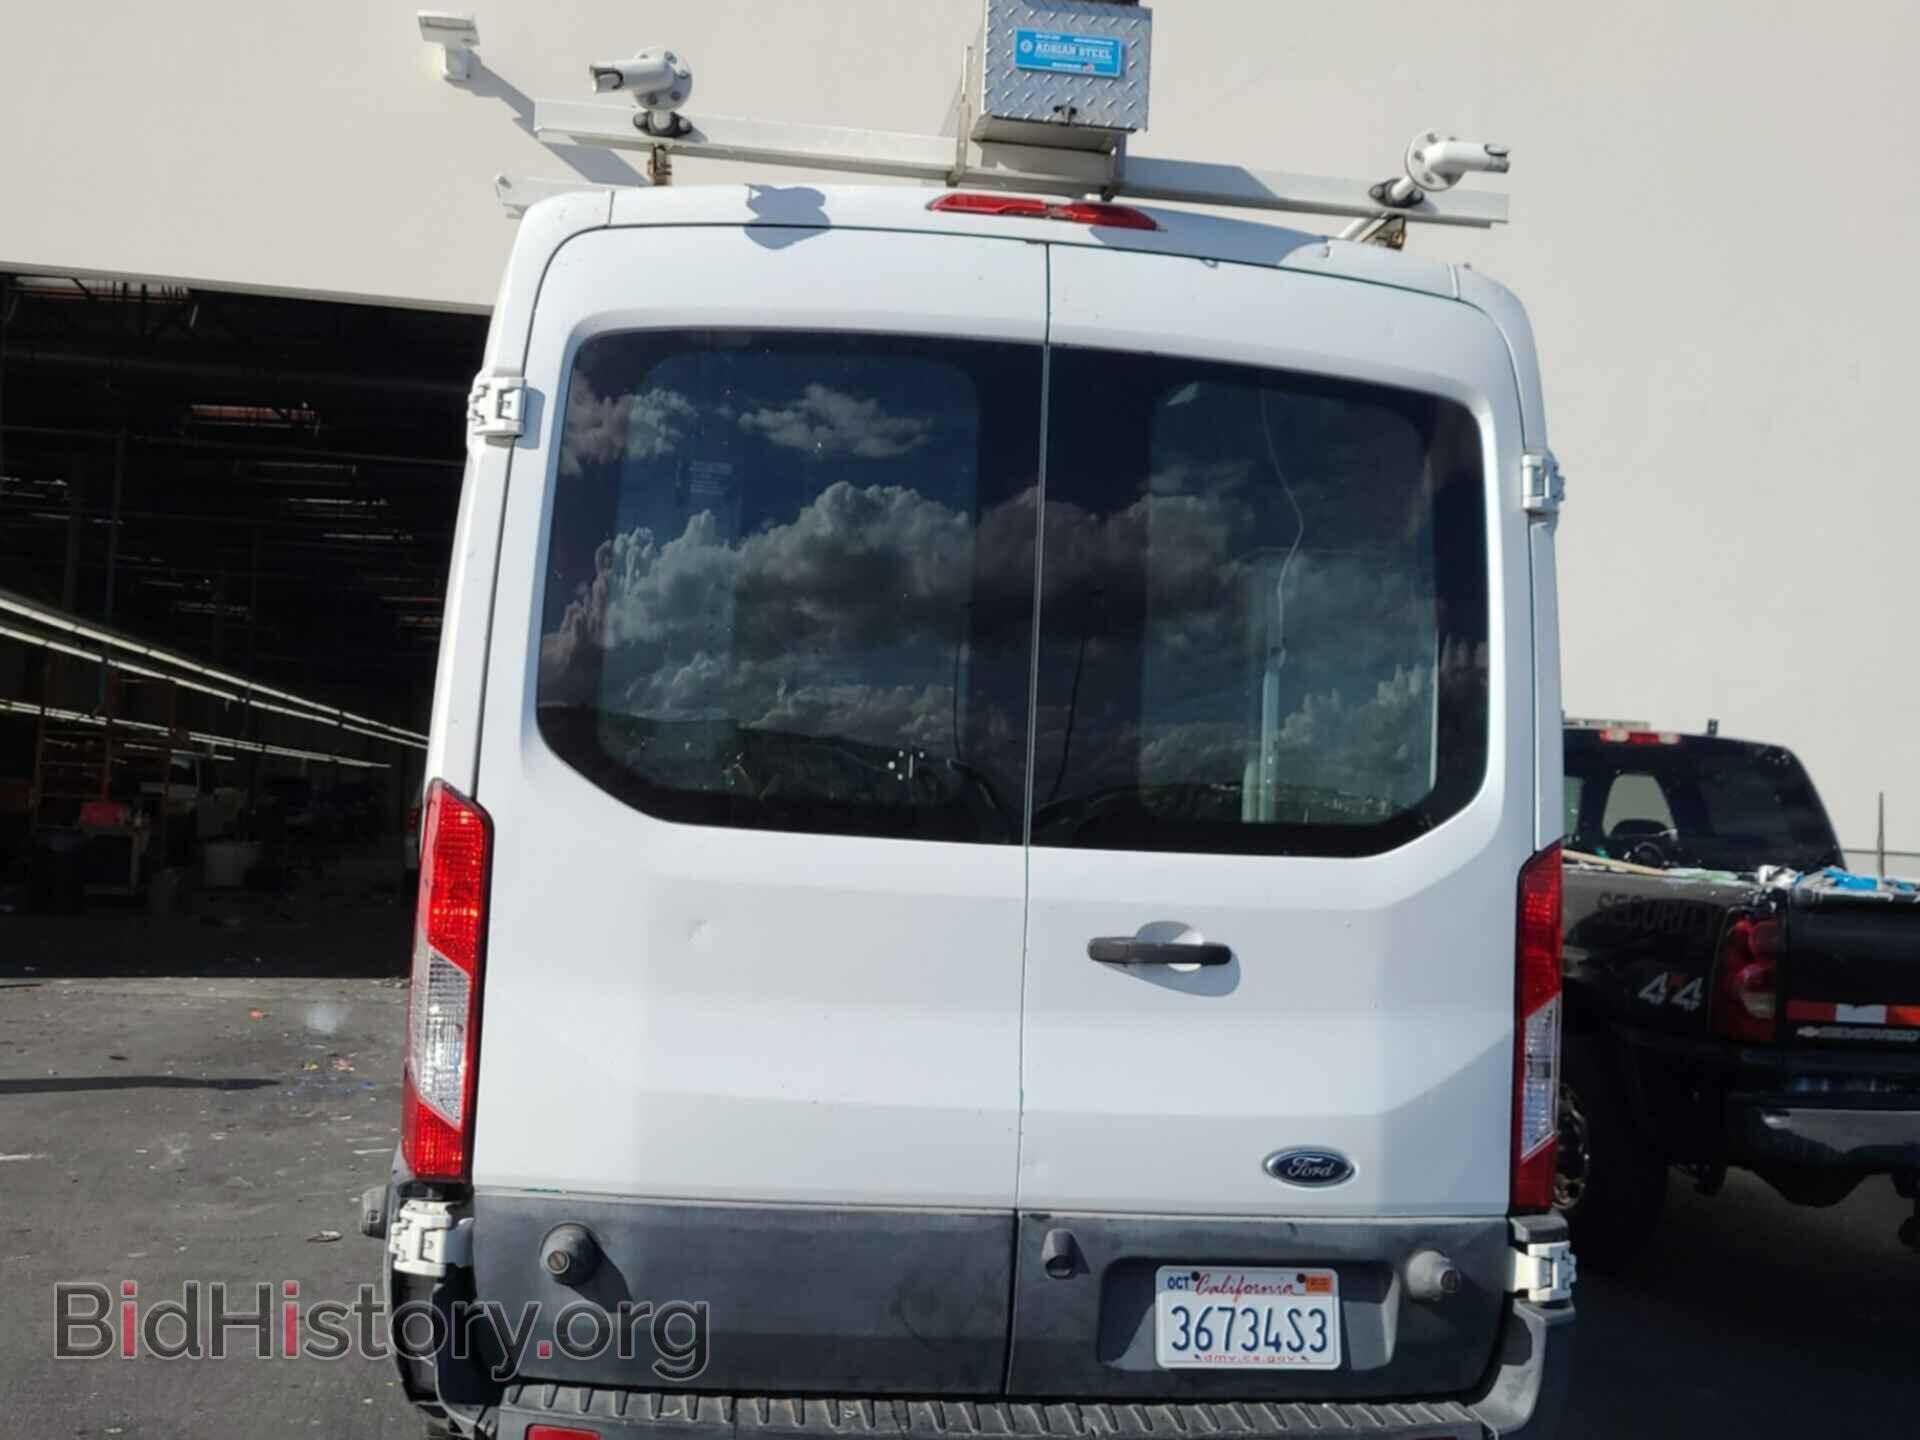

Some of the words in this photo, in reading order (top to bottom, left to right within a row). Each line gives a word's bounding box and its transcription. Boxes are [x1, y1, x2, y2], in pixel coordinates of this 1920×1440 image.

[1079, 46, 1113, 59] STEEL
[1287, 1156, 1335, 1177] Ford
[1167, 1276, 1190, 1290] OCT
[1195, 1273, 1300, 1302] California
[1171, 1305, 1328, 1353] 36734S3
[1203, 1354, 1297, 1364] dmv.ca.gov
